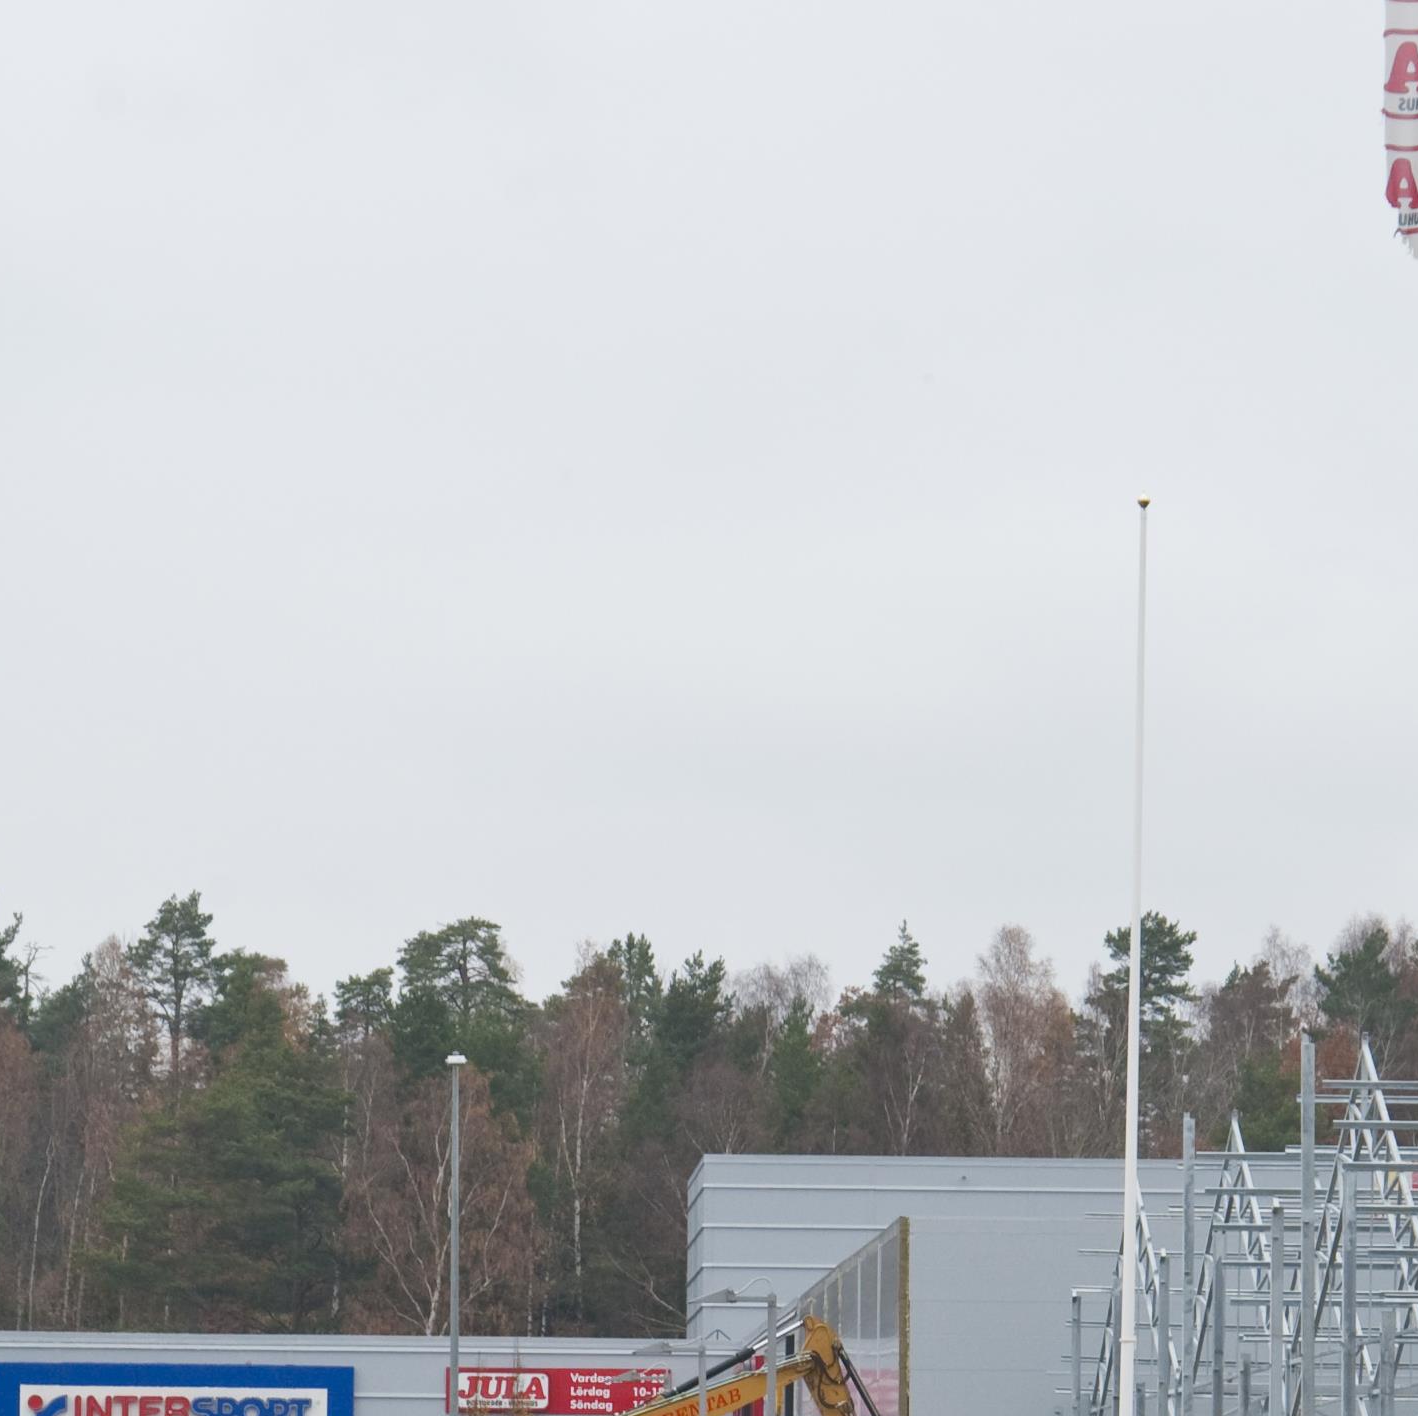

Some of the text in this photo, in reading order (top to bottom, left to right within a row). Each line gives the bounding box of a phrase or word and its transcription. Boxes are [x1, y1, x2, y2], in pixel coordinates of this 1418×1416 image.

[458, 1375, 547, 1400] JULA
[570, 1386, 611, 1399] Lördag
[570, 1400, 613, 1413] Söndag
